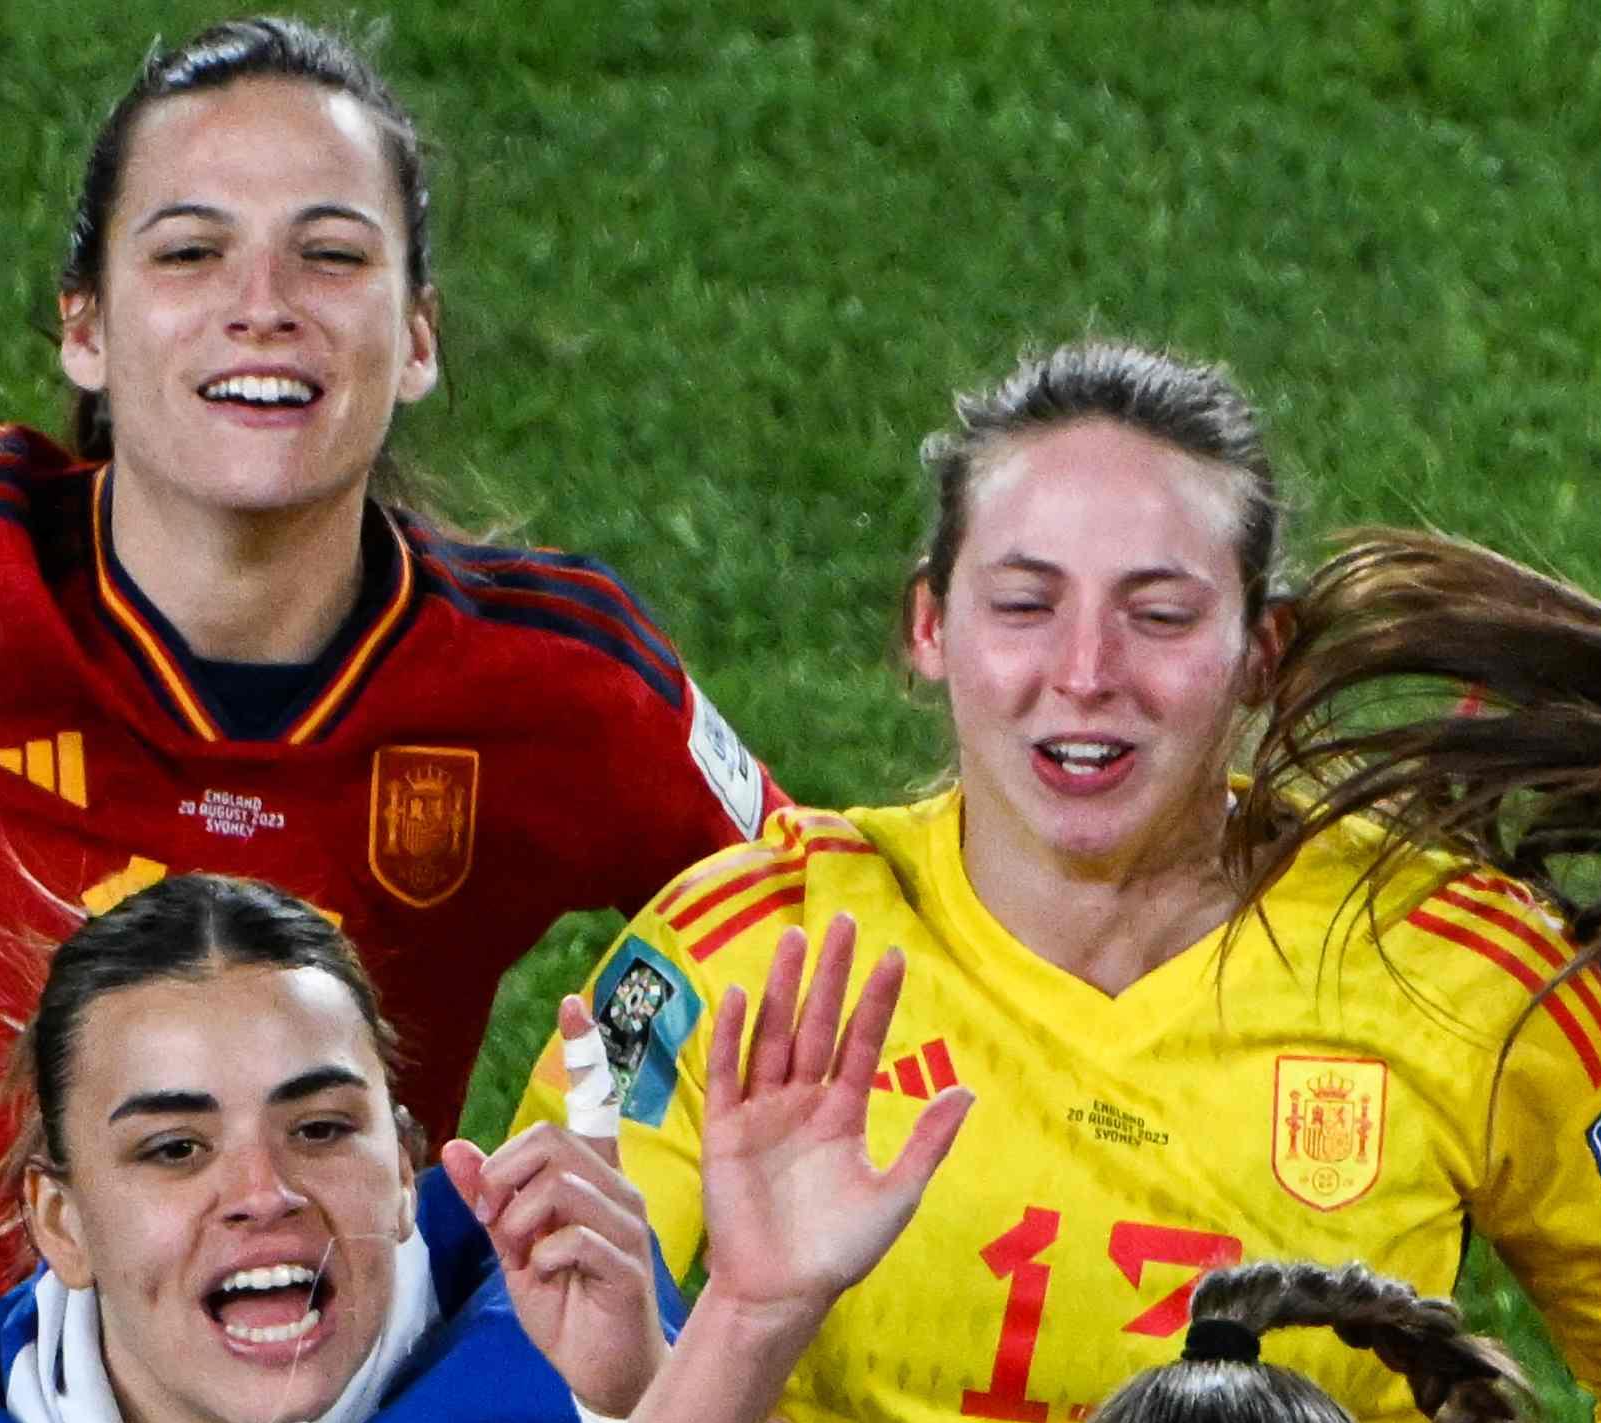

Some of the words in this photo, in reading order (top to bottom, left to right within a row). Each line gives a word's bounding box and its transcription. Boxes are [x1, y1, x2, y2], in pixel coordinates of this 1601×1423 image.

[204, 789, 262, 811] ENGLAND
[179, 799, 196, 815] 20
[199, 802, 248, 820] AUGUST
[251, 810, 285, 828] 2023
[205, 818, 255, 838] SYDNEY
[1066, 1107, 1083, 1121] 20
[1088, 1111, 1133, 1133] AUGUST
[1138, 1129, 1168, 1145] 2023
[1093, 1099, 1145, 1129] ENGLAND
[1094, 1127, 1141, 1146] SYDNEY
